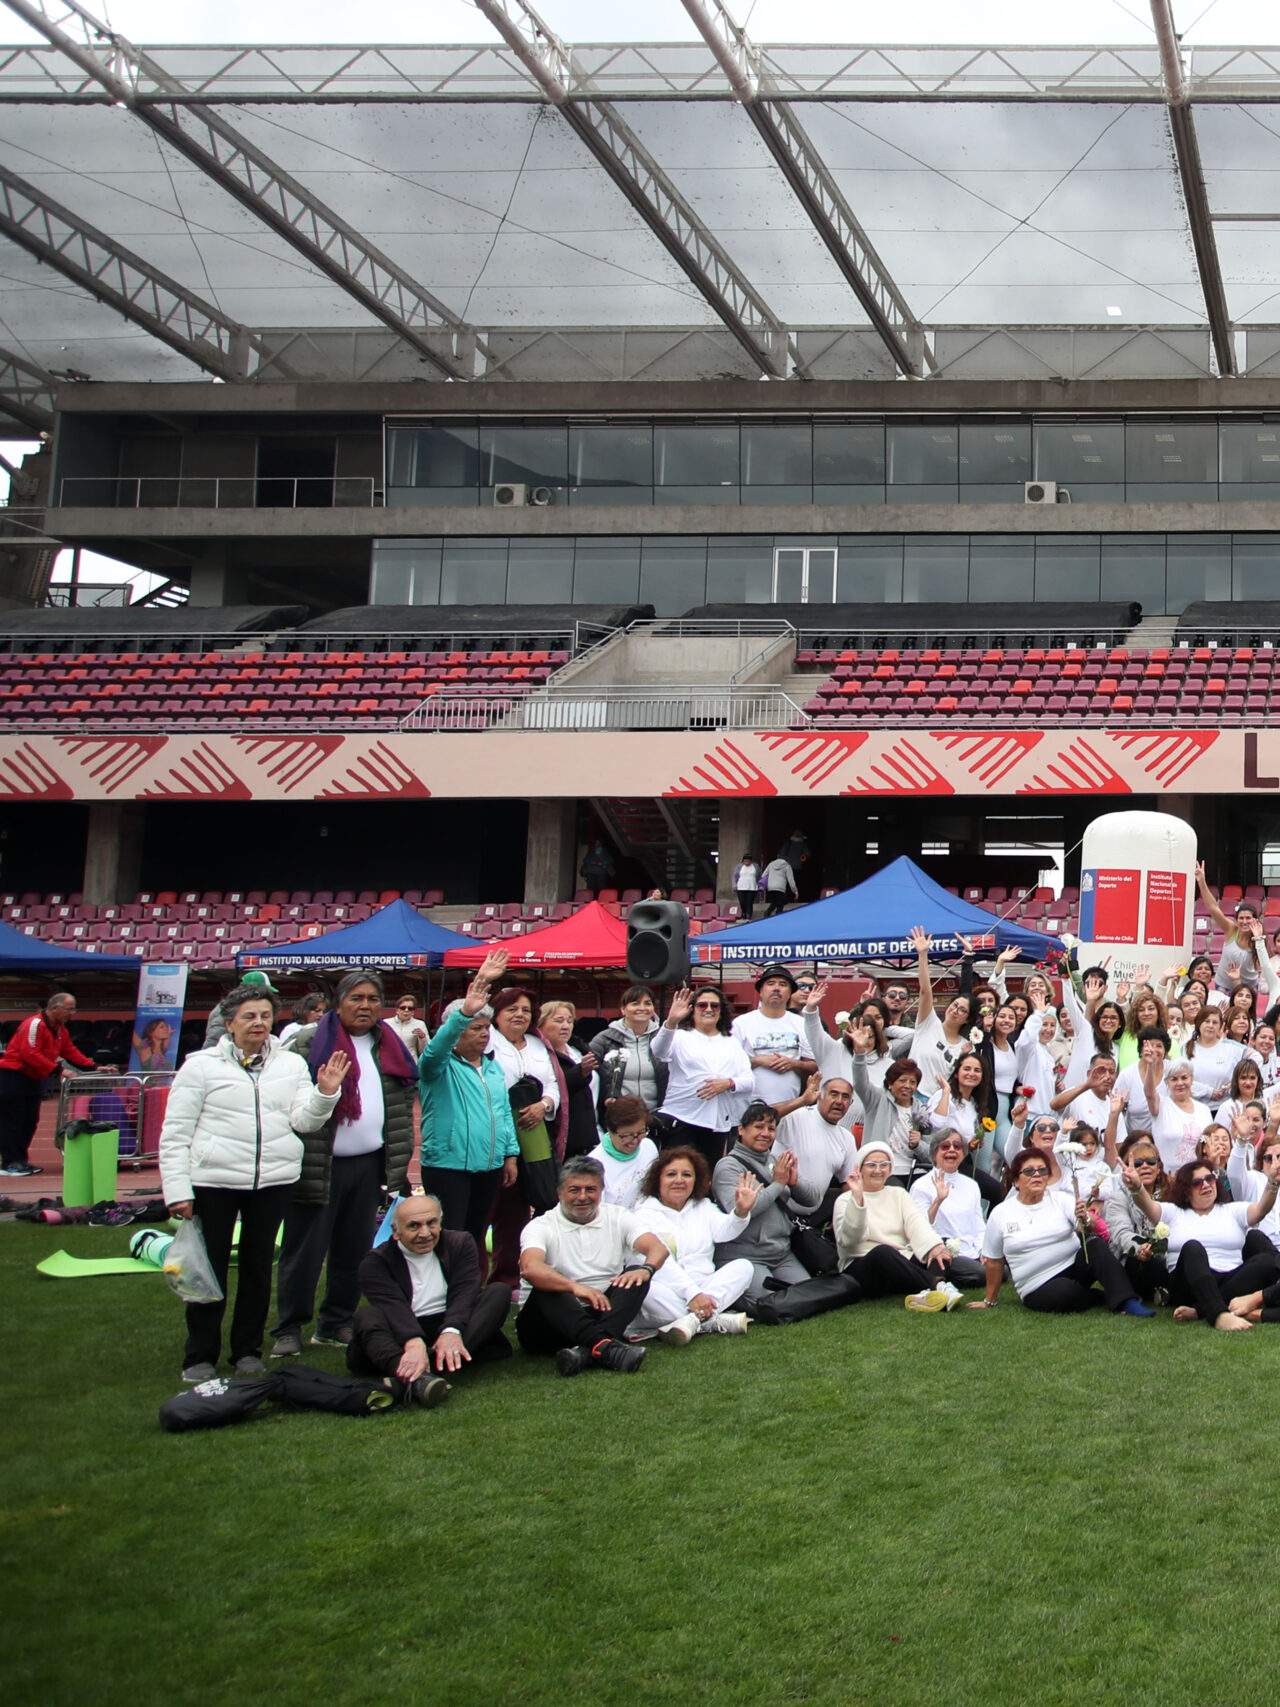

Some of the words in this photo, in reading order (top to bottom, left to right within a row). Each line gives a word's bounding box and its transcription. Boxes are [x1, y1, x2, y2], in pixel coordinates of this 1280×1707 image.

[723, 944, 793, 959] INSTITUTO
[795, 942, 865, 958] NACIONAL
[868, 941, 887, 955] DE
[890, 938, 958, 955] DEPRTES
[259, 956, 302, 966] INSTITUTO
[303, 955, 348, 965] NACIONAL
[349, 955, 362, 965] DE
[363, 954, 407, 965] DEPORTES
[1114, 960, 1137, 970] Chile
